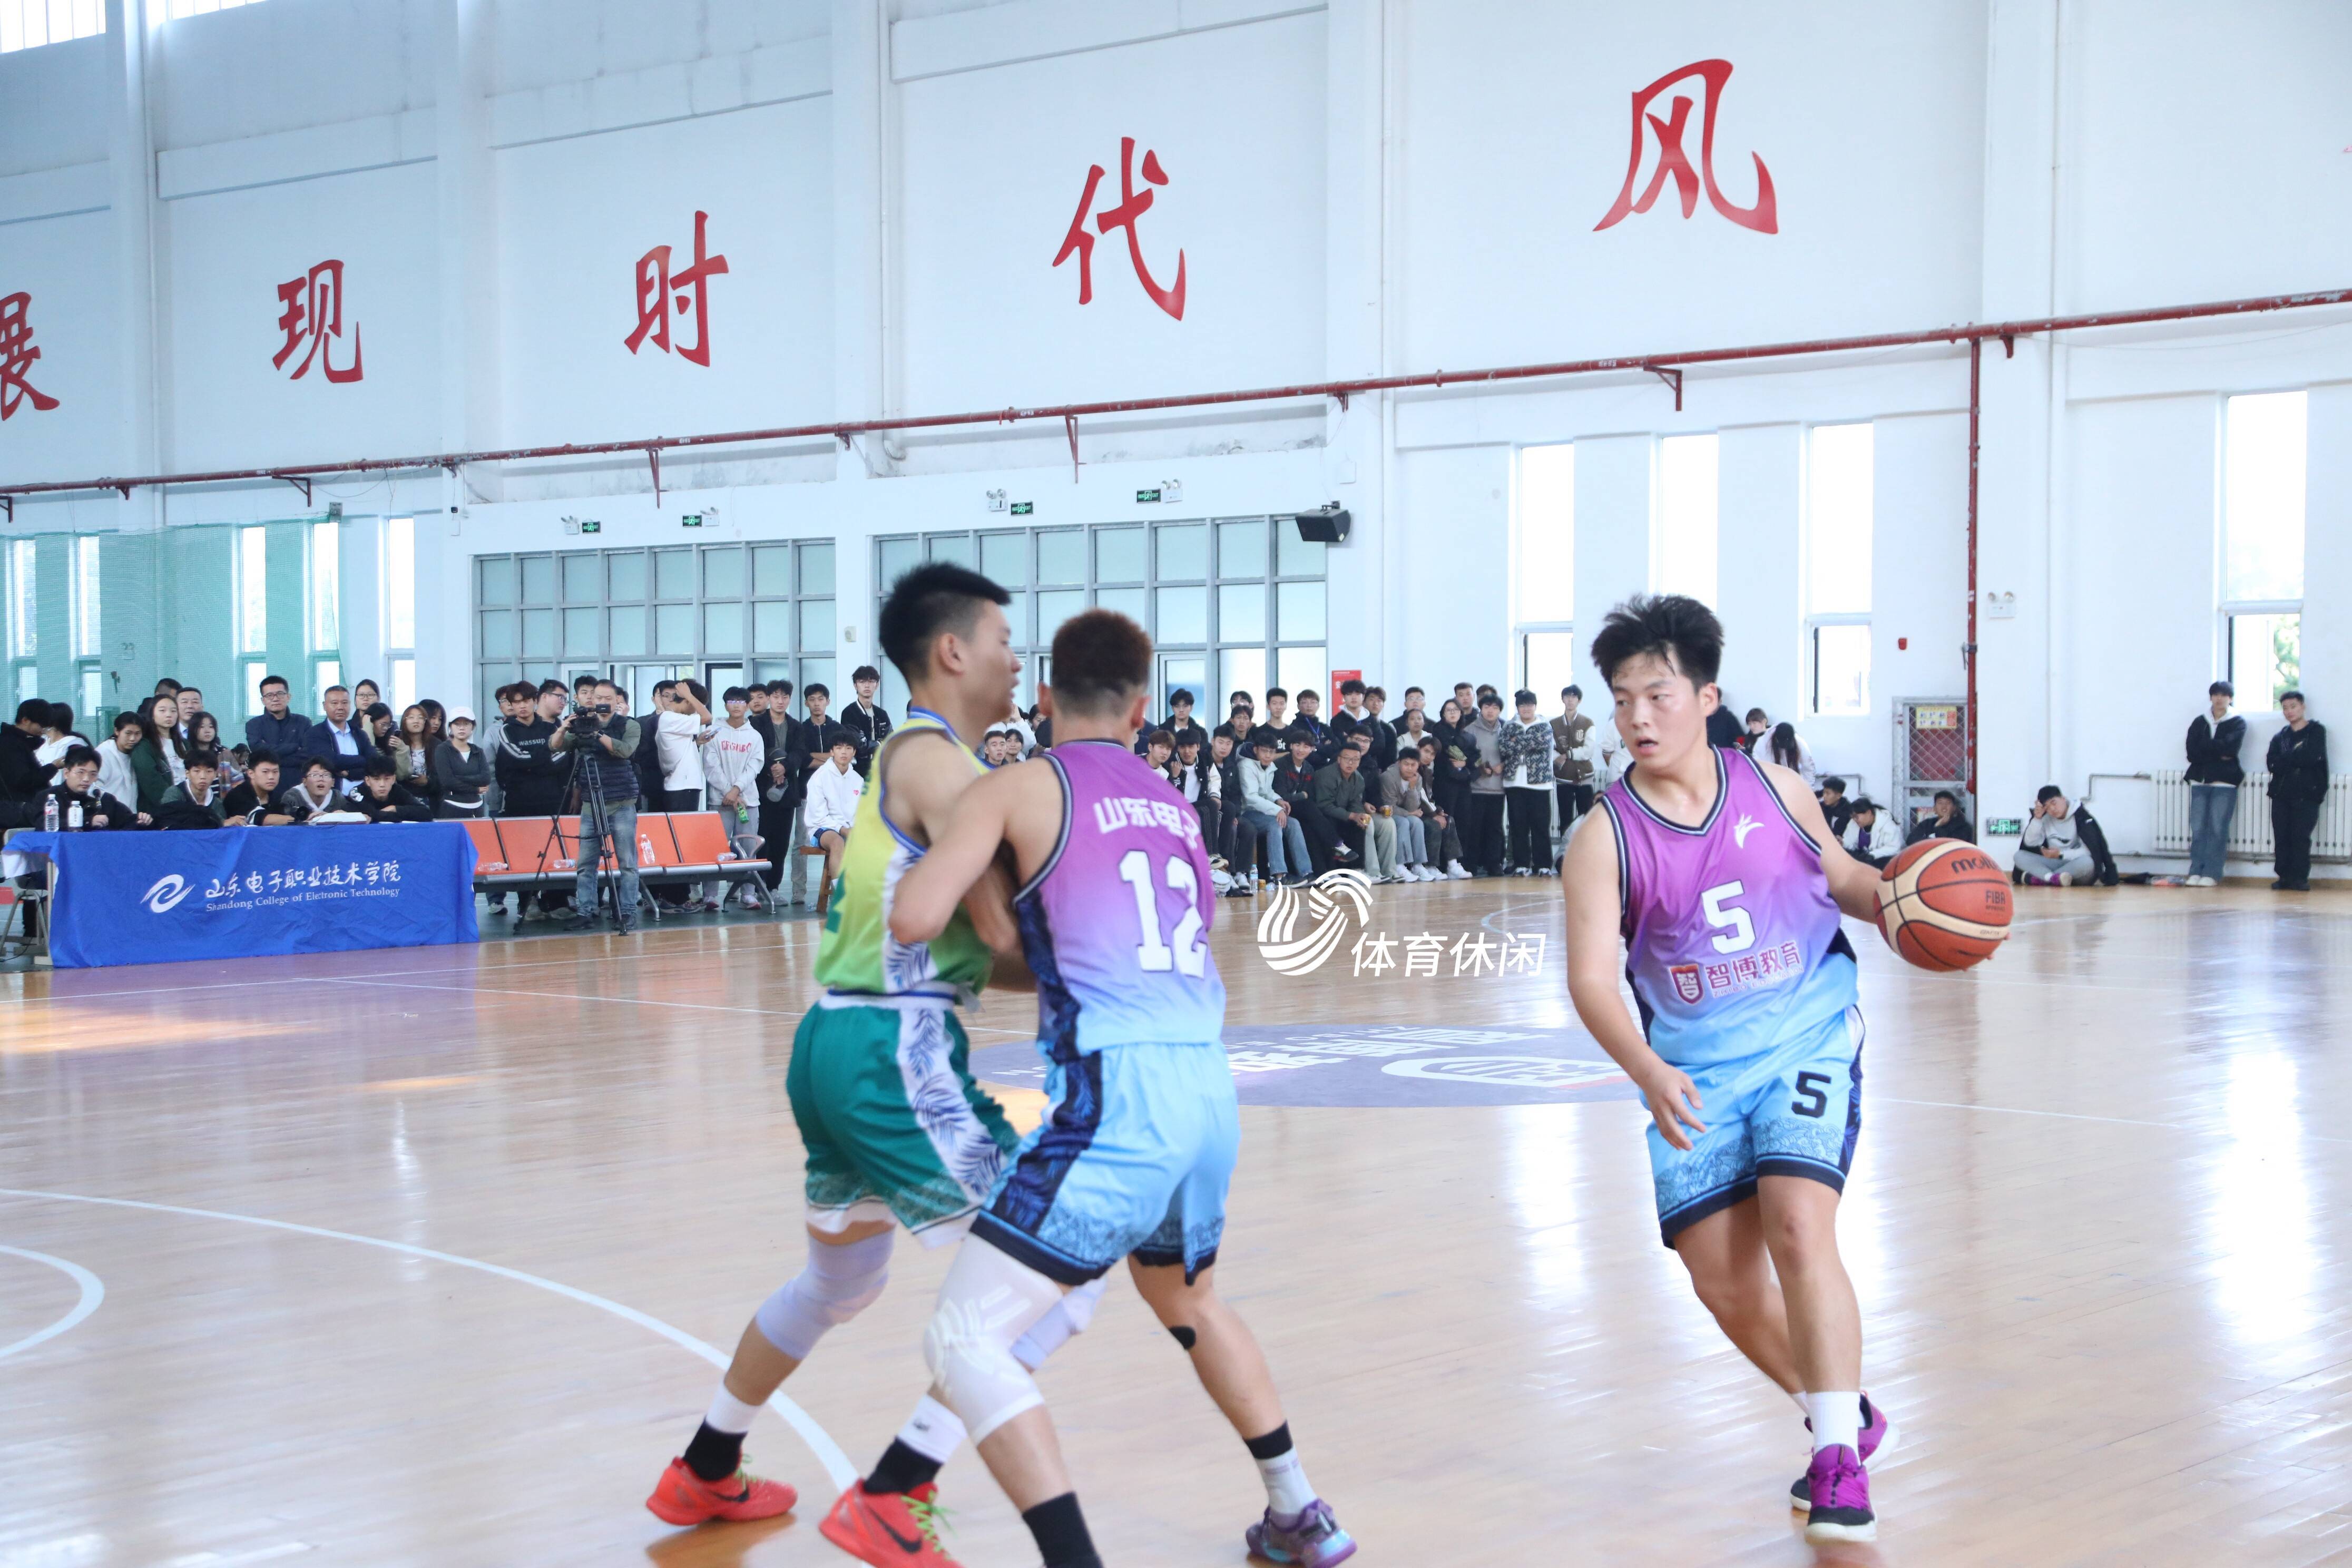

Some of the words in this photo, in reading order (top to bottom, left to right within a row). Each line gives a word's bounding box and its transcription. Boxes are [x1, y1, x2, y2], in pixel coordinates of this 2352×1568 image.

[0, 291, 60, 421] 展
[272, 259, 364, 384] 现
[624, 210, 729, 367] 时
[1052, 136, 1186, 321] 代
[1592, 58, 1778, 234] 风
[205, 860, 401, 898] 山东电子职业技术学院
[206, 898, 253, 912] Shandong
[256, 895, 289, 906] College
[293, 893, 303, 901] of
[306, 889, 348, 900] Electronic
[350, 887, 400, 897] Technology
[1986, 890, 2005, 904] FIBA
[1119, 849, 1208, 979] 12
[1701, 879, 1757, 955] 5
[1705, 941, 1800, 989] 智博教育
[1791, 1071, 1832, 1119] 5
